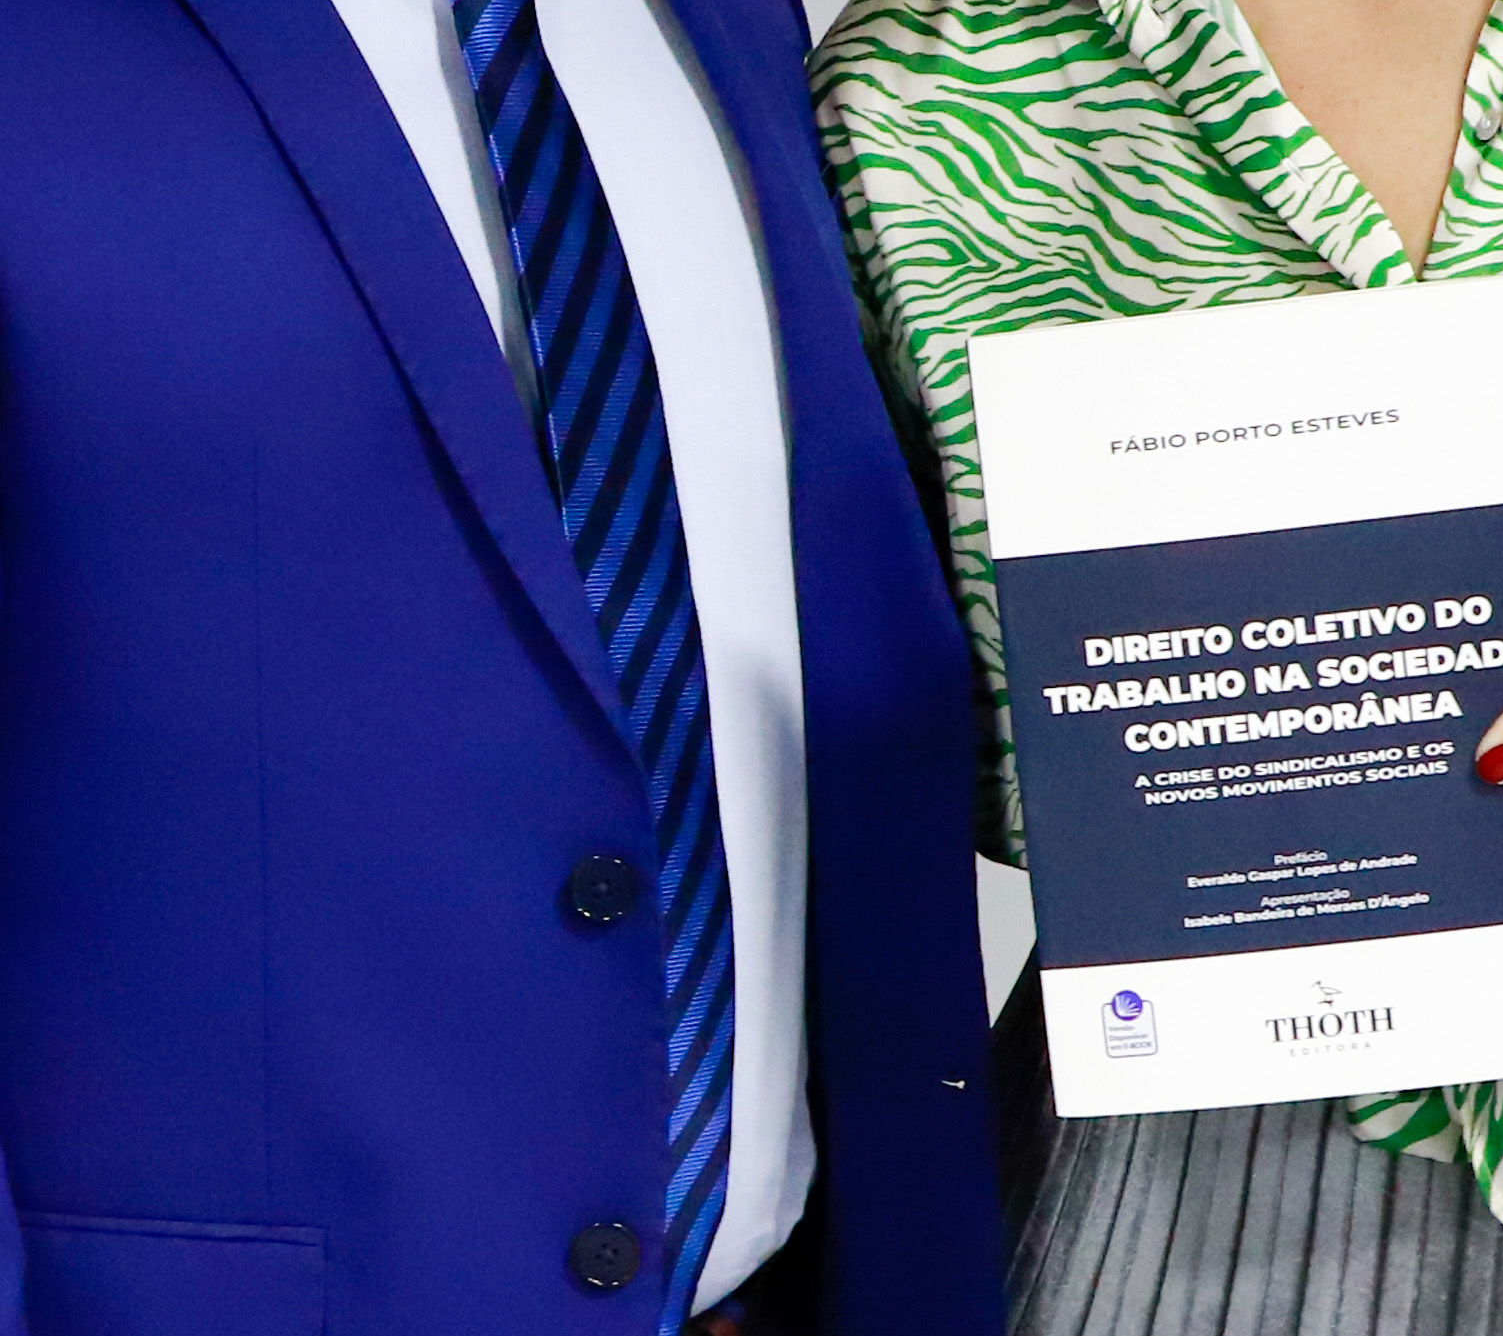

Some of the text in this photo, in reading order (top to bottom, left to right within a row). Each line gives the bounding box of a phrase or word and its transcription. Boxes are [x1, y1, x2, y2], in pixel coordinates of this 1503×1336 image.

[1110, 408, 1400, 455] FÁBIO PORTO ESTEVES
[1084, 595, 1493, 667] DIREITO COLETIVO DO
[1042, 669, 1247, 715] TRABALHO
[1253, 662, 1313, 695] NA
[1123, 690, 1463, 753] CONTEMPORÂNEA
[1134, 741, 1456, 788] A CRISE DO SINDICALISMO E OS
[1144, 760, 1450, 806] NOVOS MOVIMENTOS SOCIAIS
[1186, 853, 1419, 890] Everaldo Gaspar Lopes de Andrade
[1273, 849, 1329, 866] Prefácio
[1183, 892, 1430, 928] Isabele Bandeira de Moraes D'Ângelo
[1259, 887, 1351, 911] Apresentação
[1272, 1007, 1394, 1043] THOTH
[1288, 1041, 1372, 1058] EDITORA
